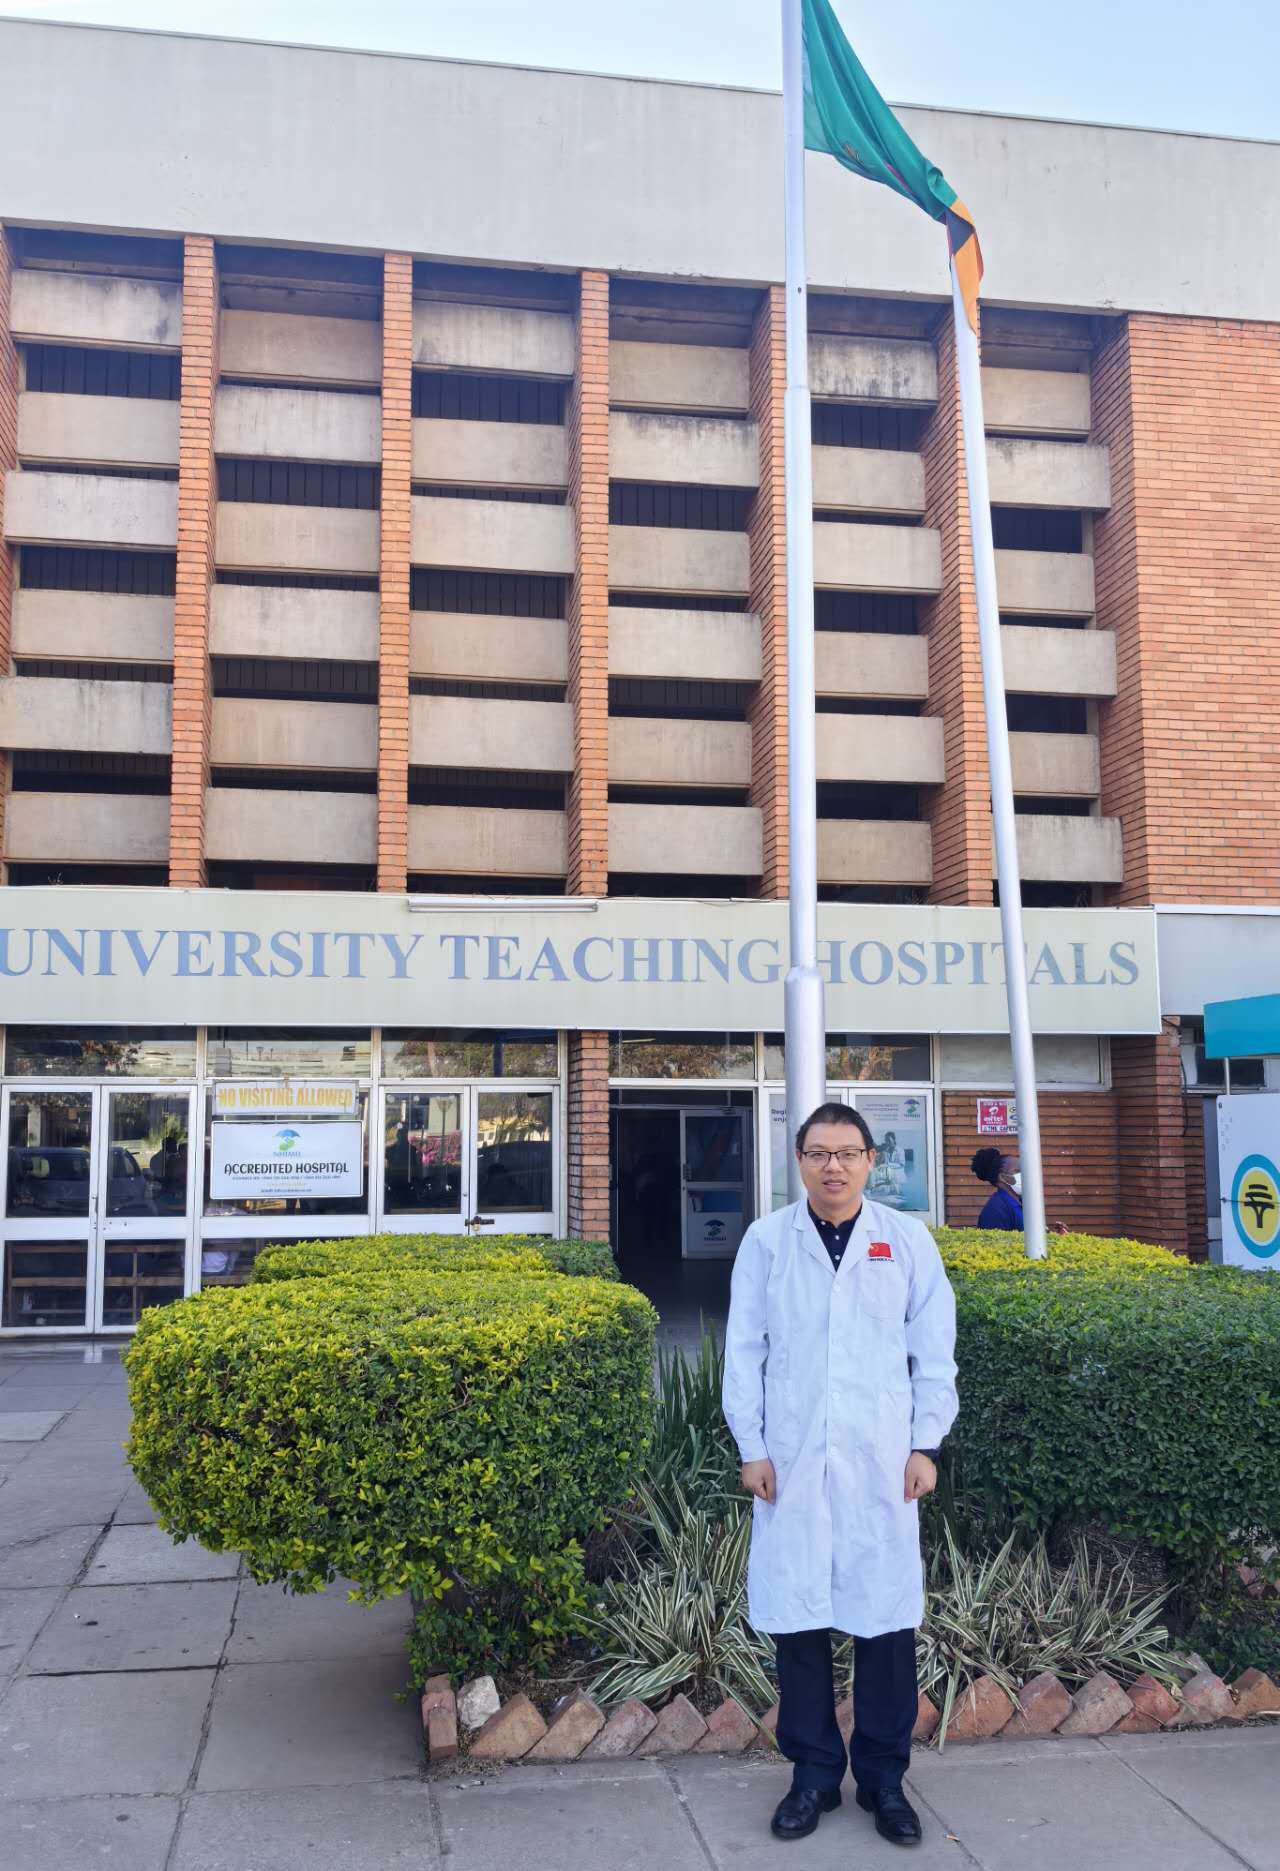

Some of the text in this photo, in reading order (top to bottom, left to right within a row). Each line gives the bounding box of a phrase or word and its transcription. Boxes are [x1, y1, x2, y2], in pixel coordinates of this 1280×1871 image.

[0, 928, 424, 978] UNIVERSITY
[440, 934, 781, 985] TEACHING
[218, 1088, 352, 1106] NO VISITING ALLOWED
[224, 1162, 350, 1176] ACCREDITED HOSPITAL
